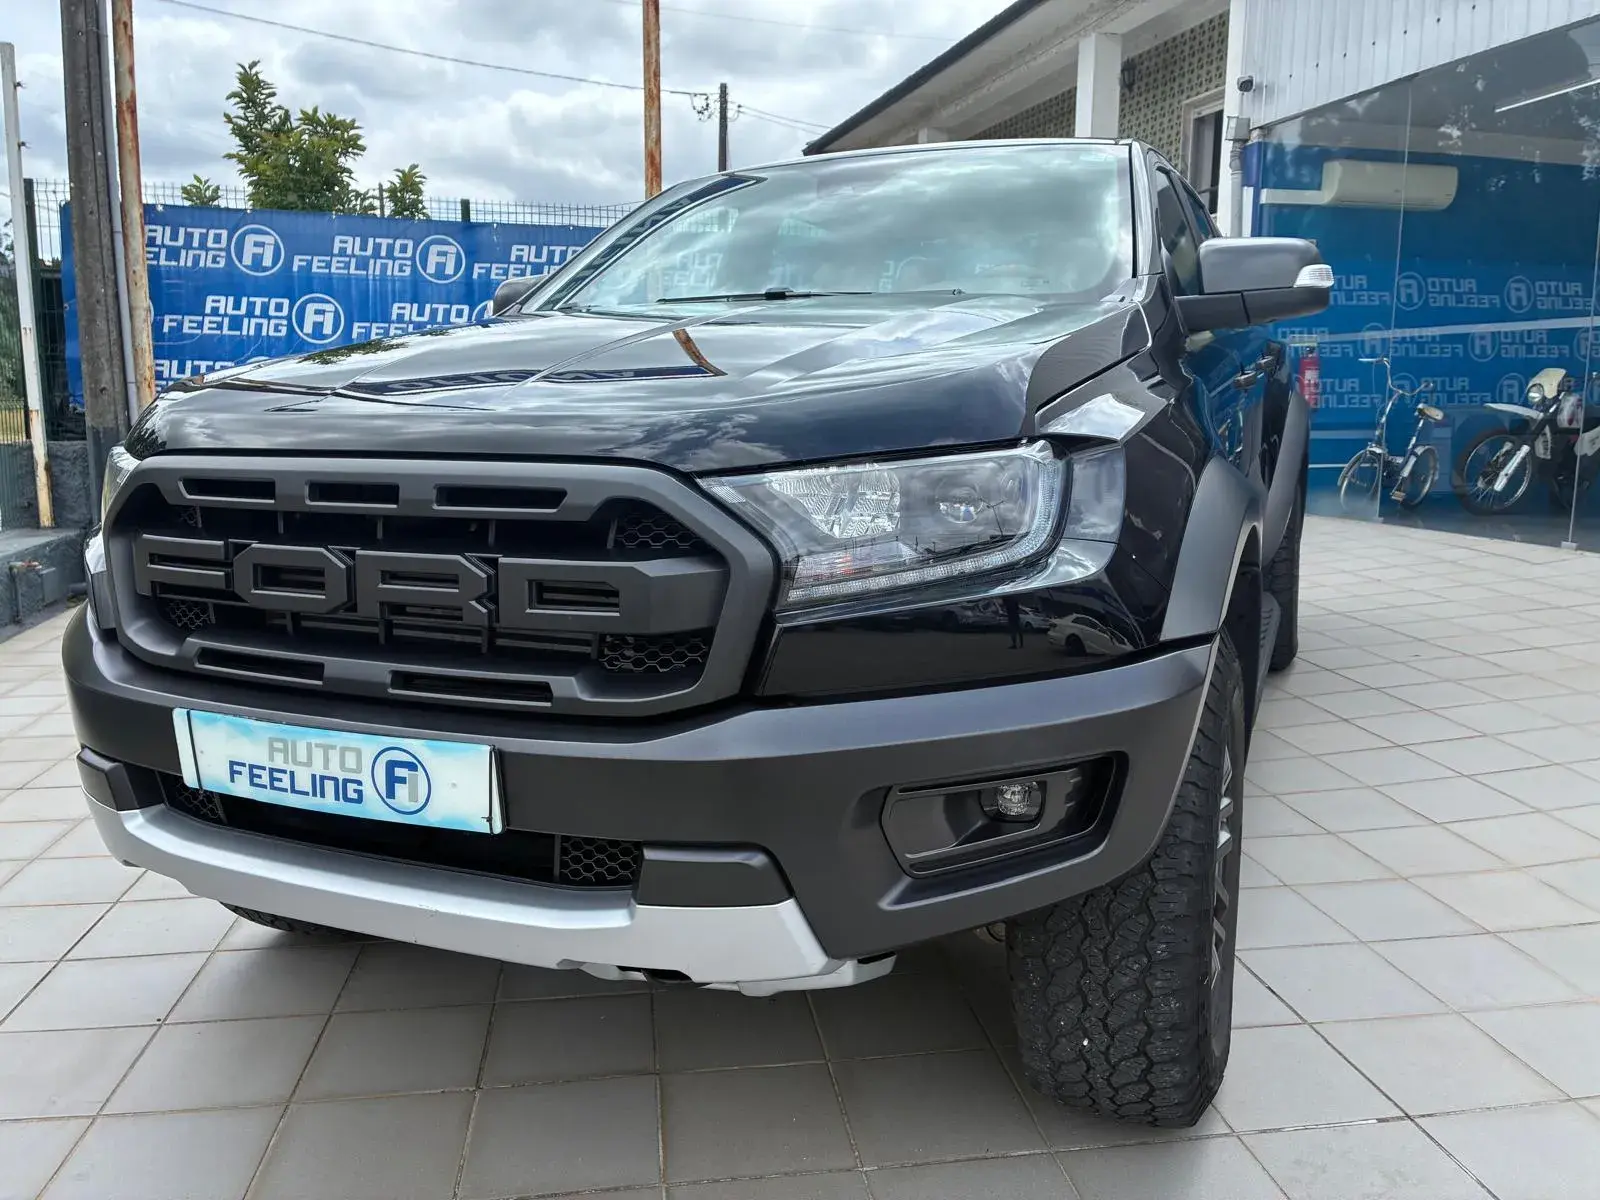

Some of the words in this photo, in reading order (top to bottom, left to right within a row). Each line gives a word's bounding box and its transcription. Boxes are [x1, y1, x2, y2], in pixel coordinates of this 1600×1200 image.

[145, 224, 228, 248] AUTO
[333, 235, 414, 258] AUTO
[145, 247, 226, 268] ELING
[292, 255, 412, 277] FEELING
[205, 295, 290, 317] AUTO
[391, 302, 470, 323] AUTO
[162, 314, 288, 337] FEELING
[135, 532, 660, 634] FORD
[268, 737, 363, 775] AUTO
[229, 760, 364, 804] FEELING
